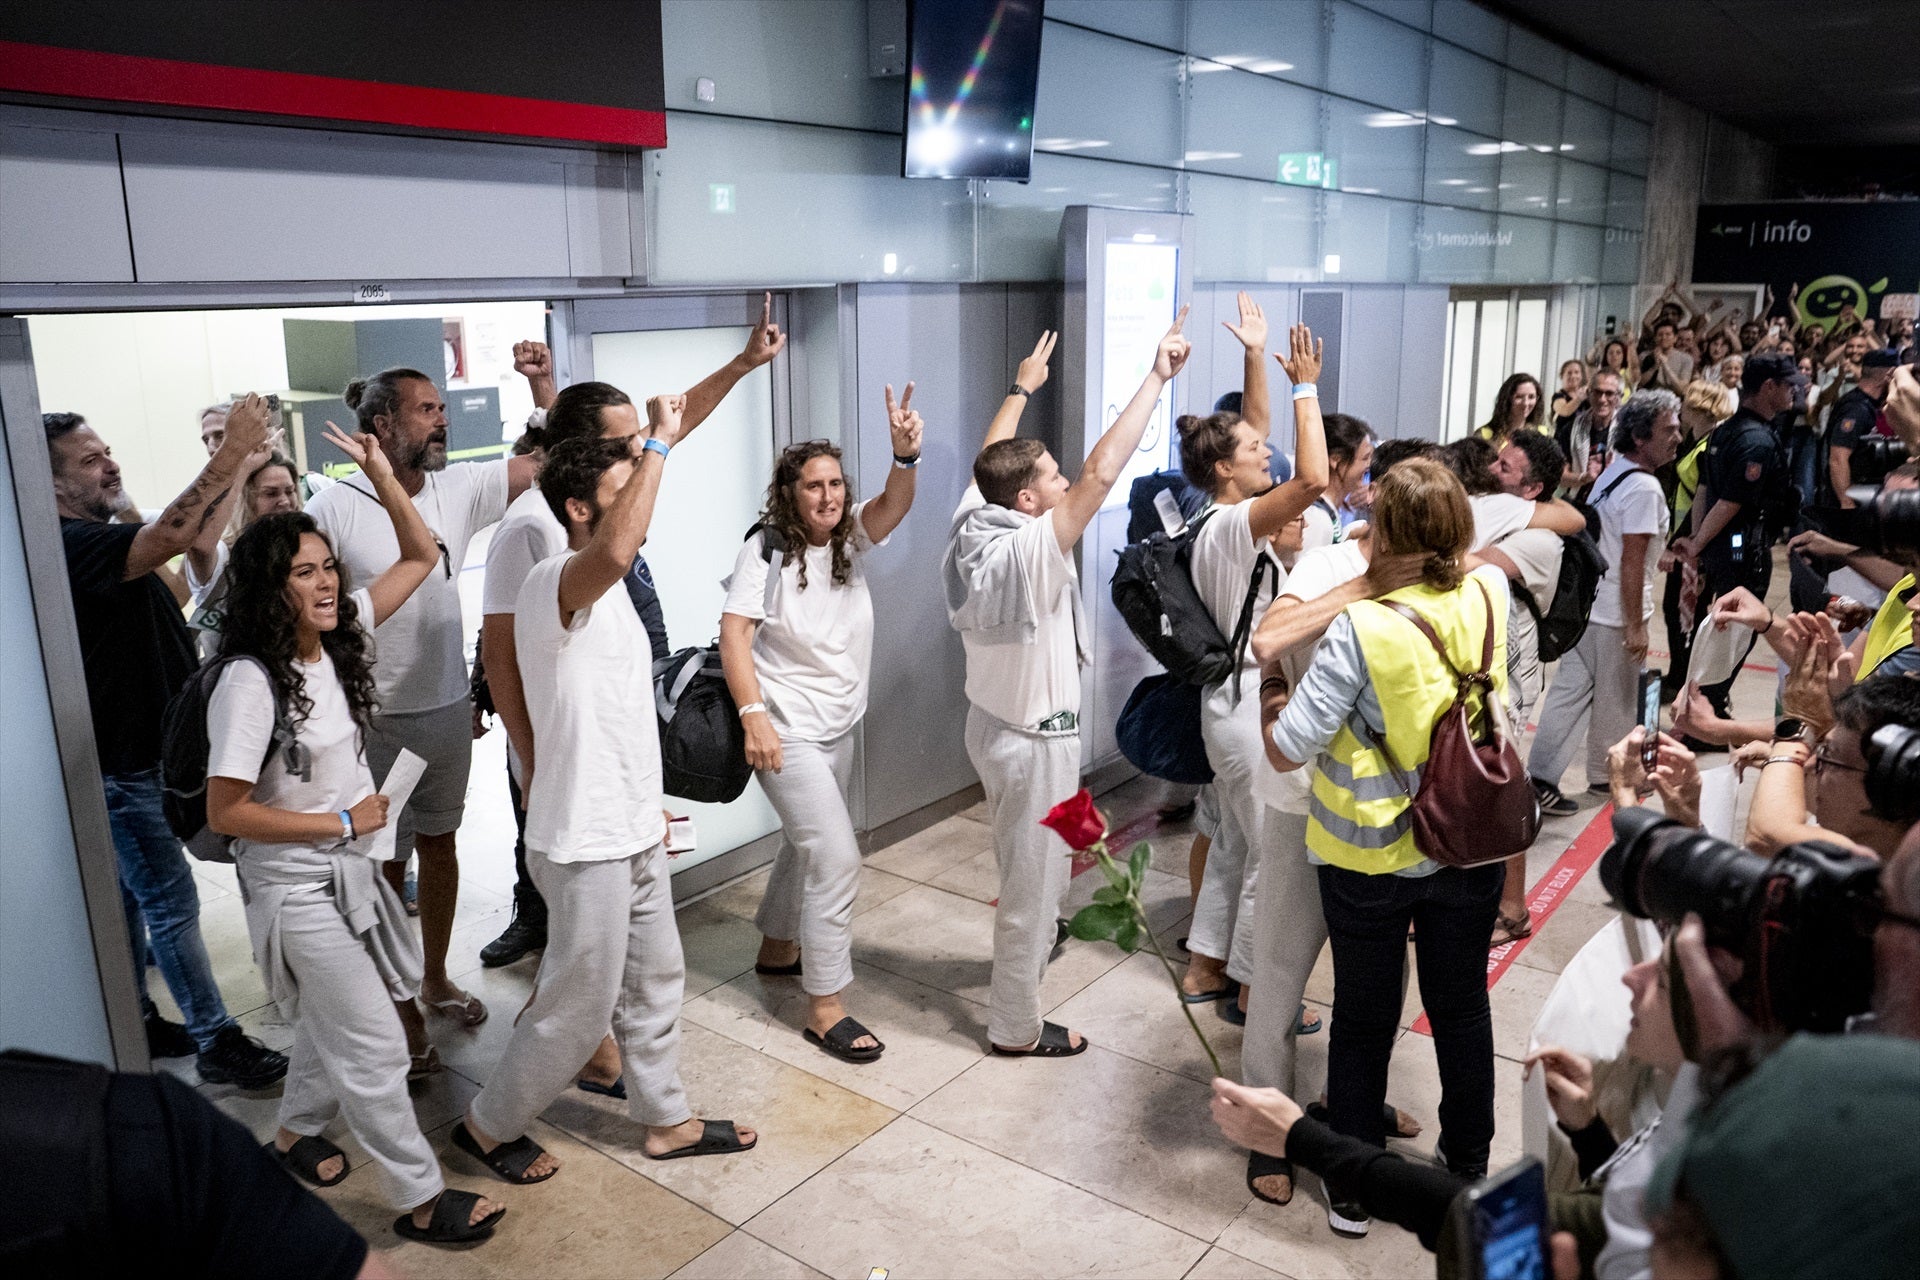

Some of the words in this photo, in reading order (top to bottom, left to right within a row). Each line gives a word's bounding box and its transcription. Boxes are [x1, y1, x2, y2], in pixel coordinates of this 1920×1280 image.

[1763, 219, 1812, 243] info
[360, 284, 384, 298] 2085
[1548, 867, 1576, 889] BLOCK
